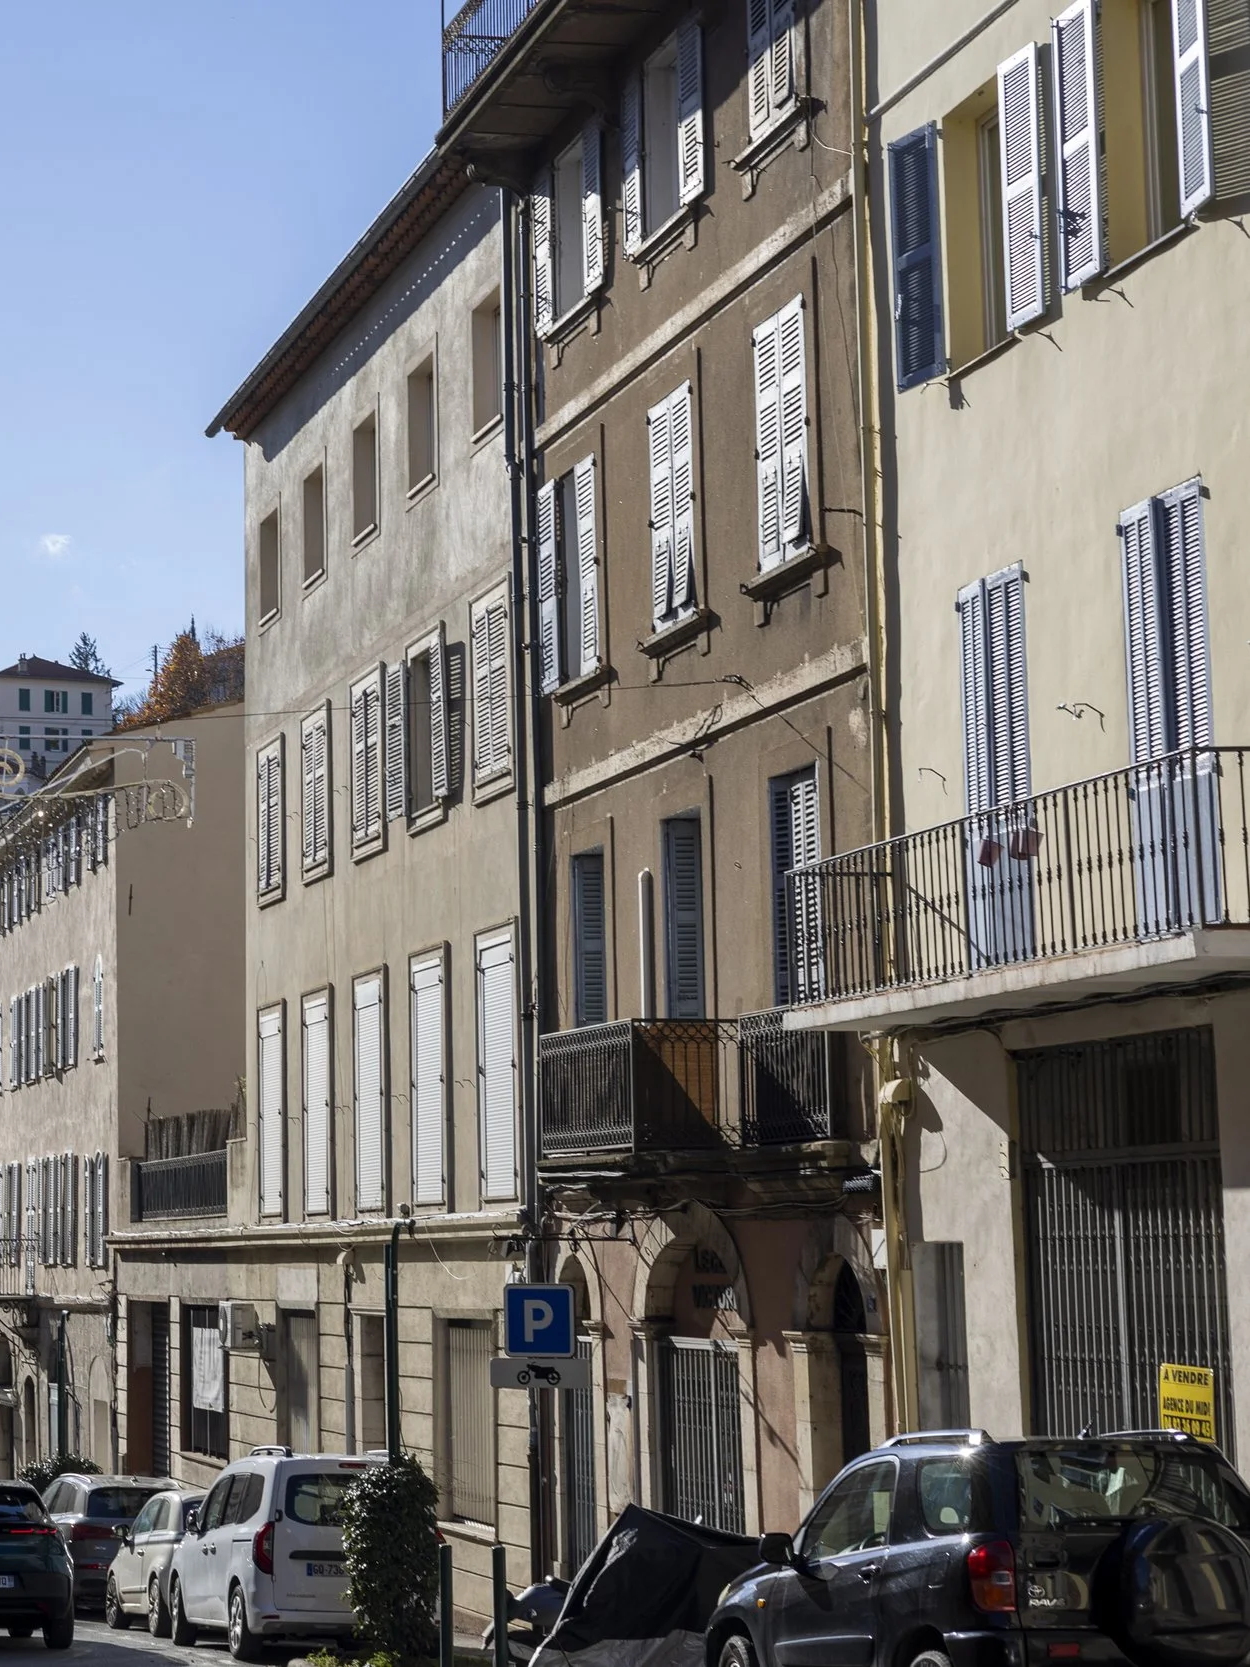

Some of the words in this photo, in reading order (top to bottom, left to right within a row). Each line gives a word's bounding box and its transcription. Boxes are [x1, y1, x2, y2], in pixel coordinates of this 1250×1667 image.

[523, 1299, 554, 1343] P
[1164, 1369, 1169, 1381] A
[1172, 1370, 1209, 1386] VENDRE
[1163, 1396, 1184, 1412] AGENCE
[1185, 1399, 1193, 1414] DU
[1196, 1400, 1211, 1416] MIDI
